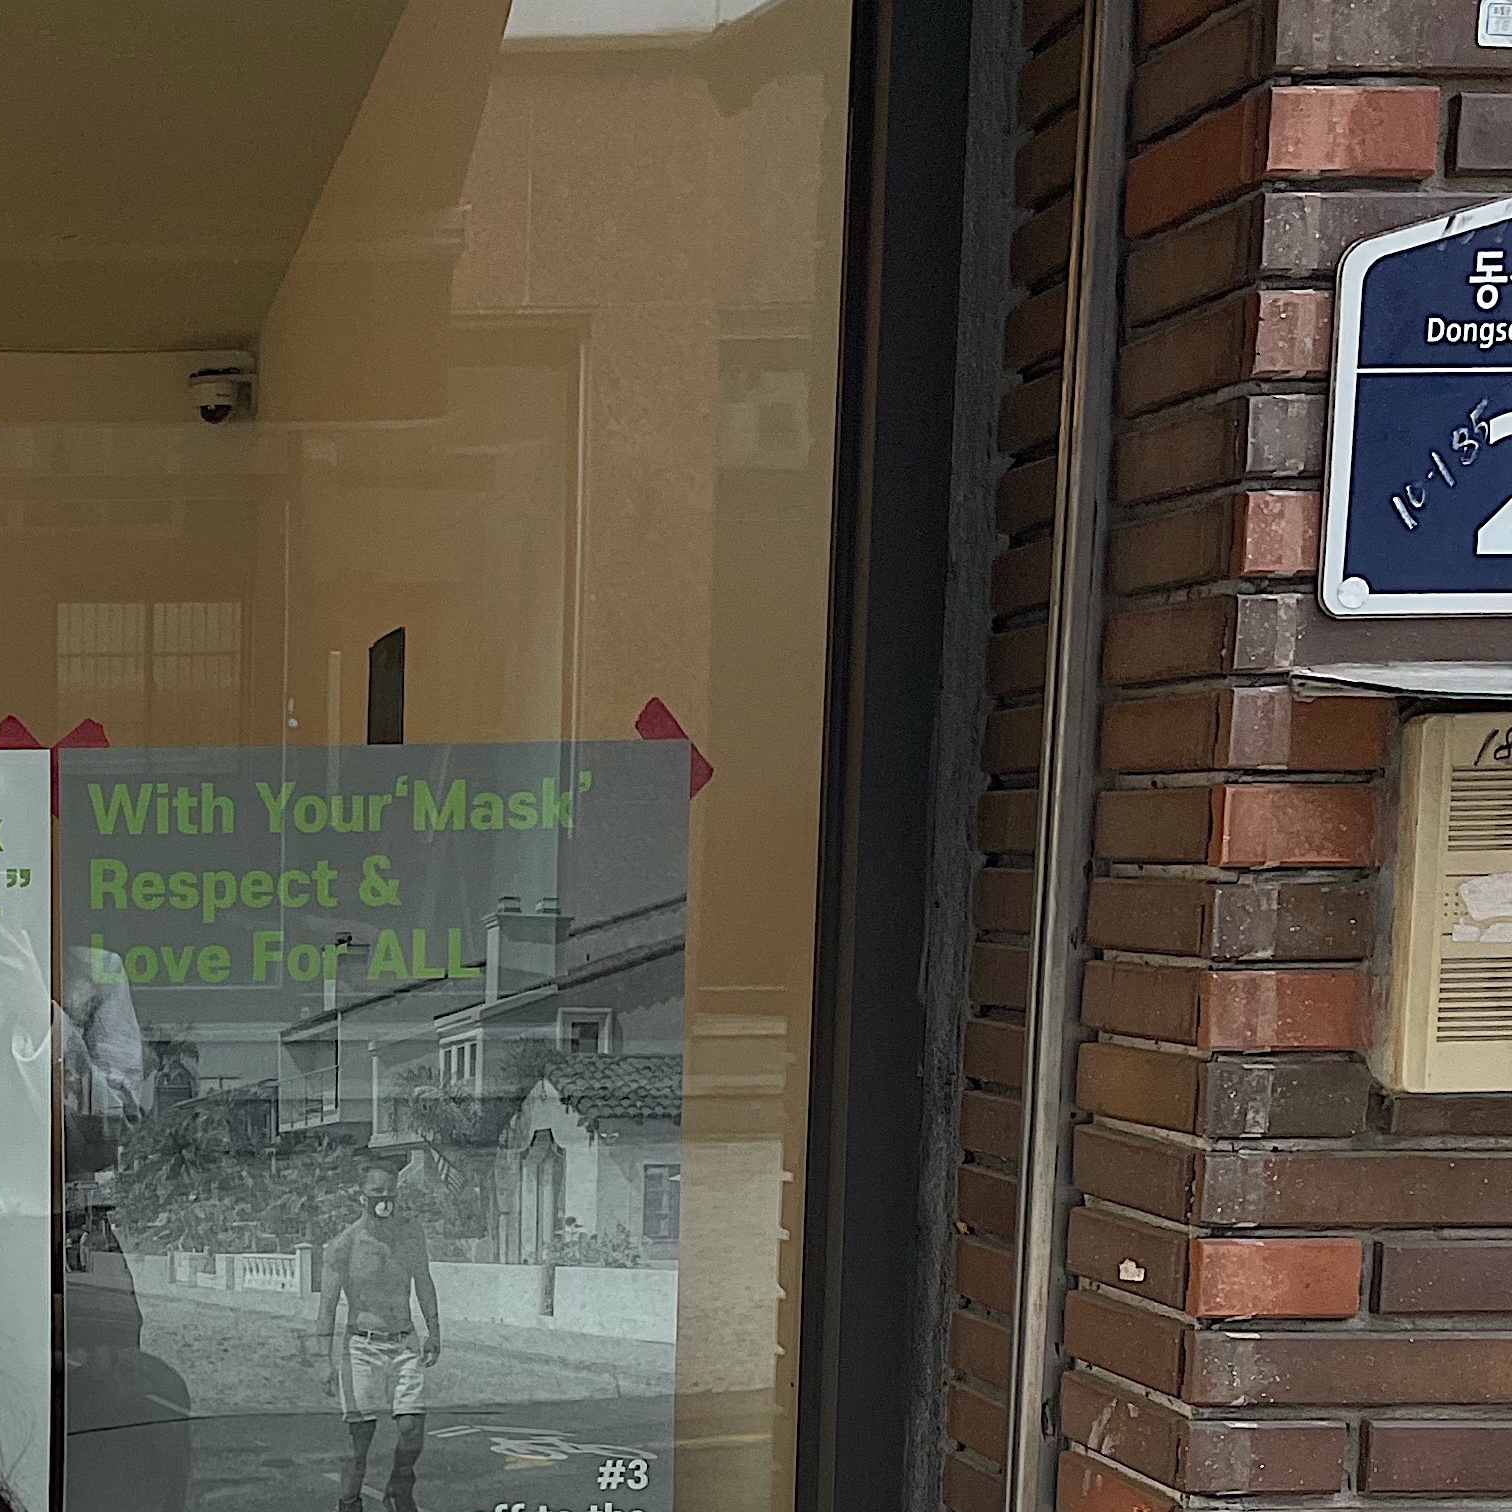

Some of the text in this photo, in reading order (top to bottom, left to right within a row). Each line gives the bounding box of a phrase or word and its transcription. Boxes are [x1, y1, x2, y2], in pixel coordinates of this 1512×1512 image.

[89, 782, 236, 834] With
[89, 854, 402, 923] Respect &
[90, 928, 486, 985] Love For ALL
[595, 1457, 650, 1491] #3
